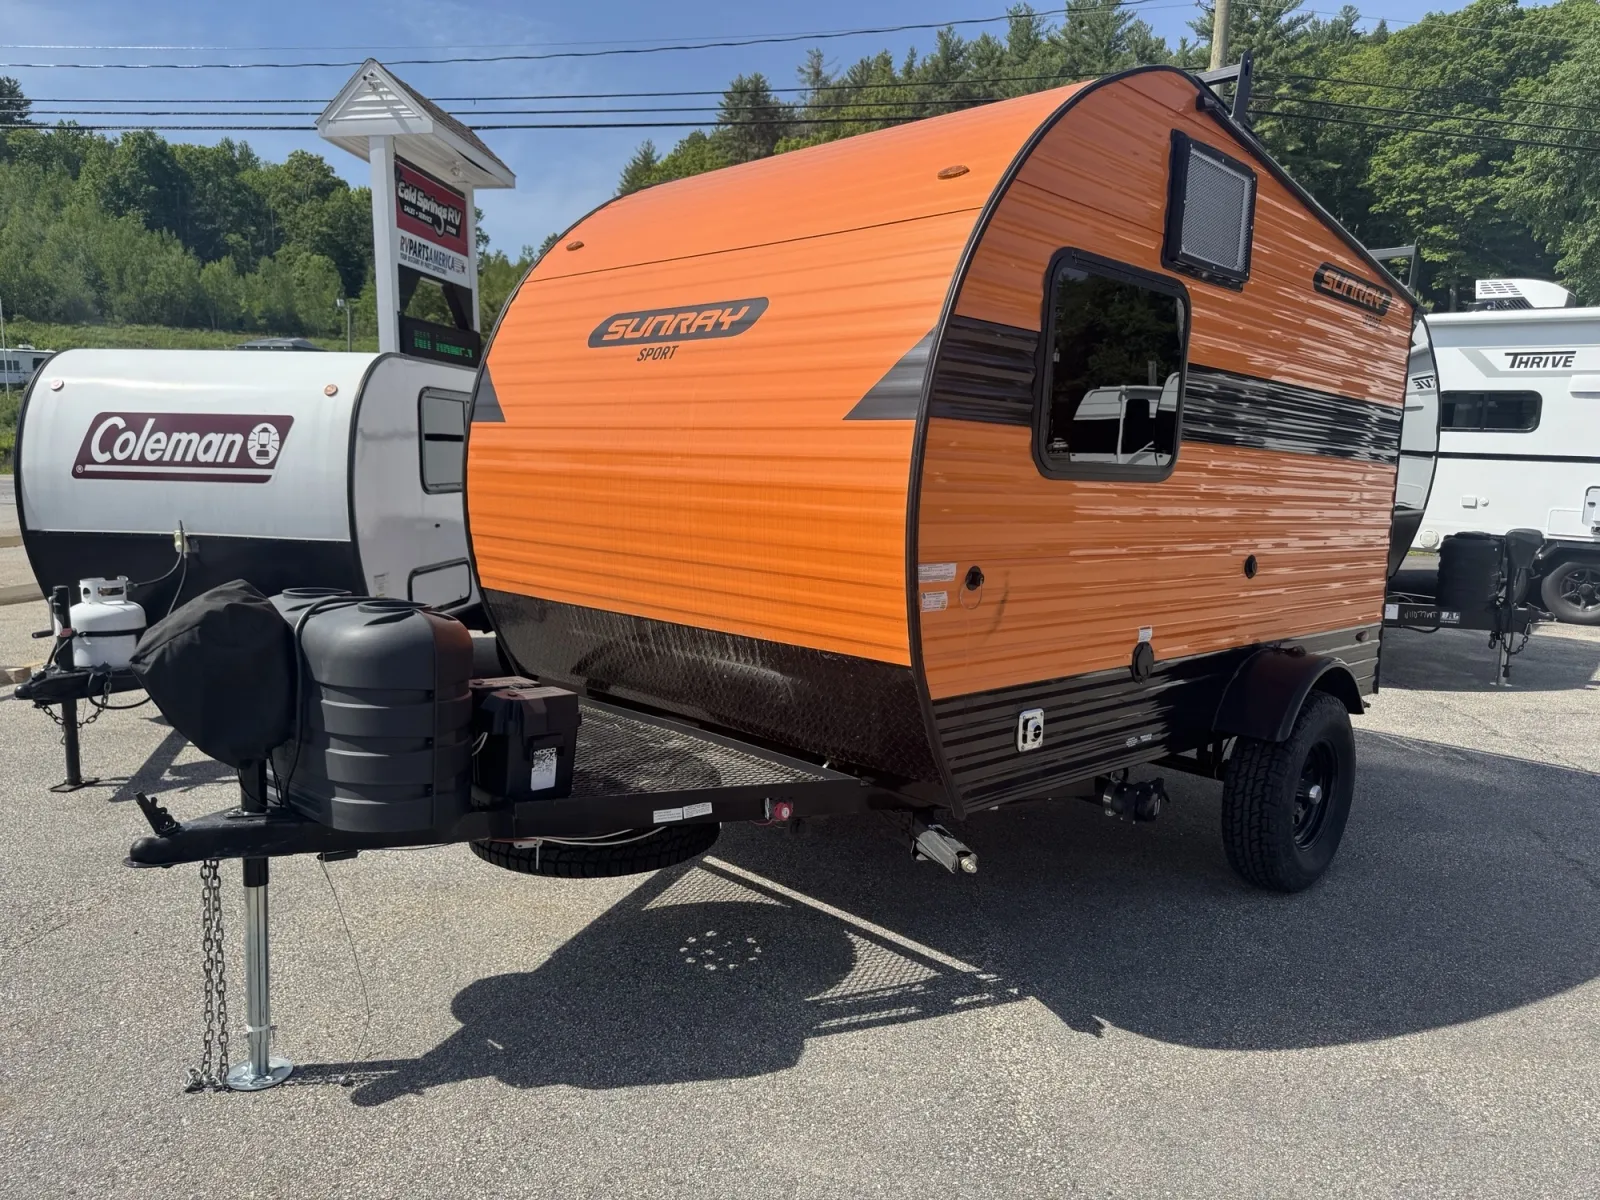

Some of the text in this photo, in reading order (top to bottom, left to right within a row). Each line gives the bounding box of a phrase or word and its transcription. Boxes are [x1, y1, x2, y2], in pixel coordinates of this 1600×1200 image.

[398, 182, 462, 235] Cold Springs RV
[1321, 269, 1384, 309] SUNRAY
[602, 306, 750, 341] SUNRAY
[636, 345, 679, 362] SPORT
[1504, 351, 1577, 369] THRIVE
[90, 416, 244, 463] Coleman
[533, 747, 557, 755] NOCO
